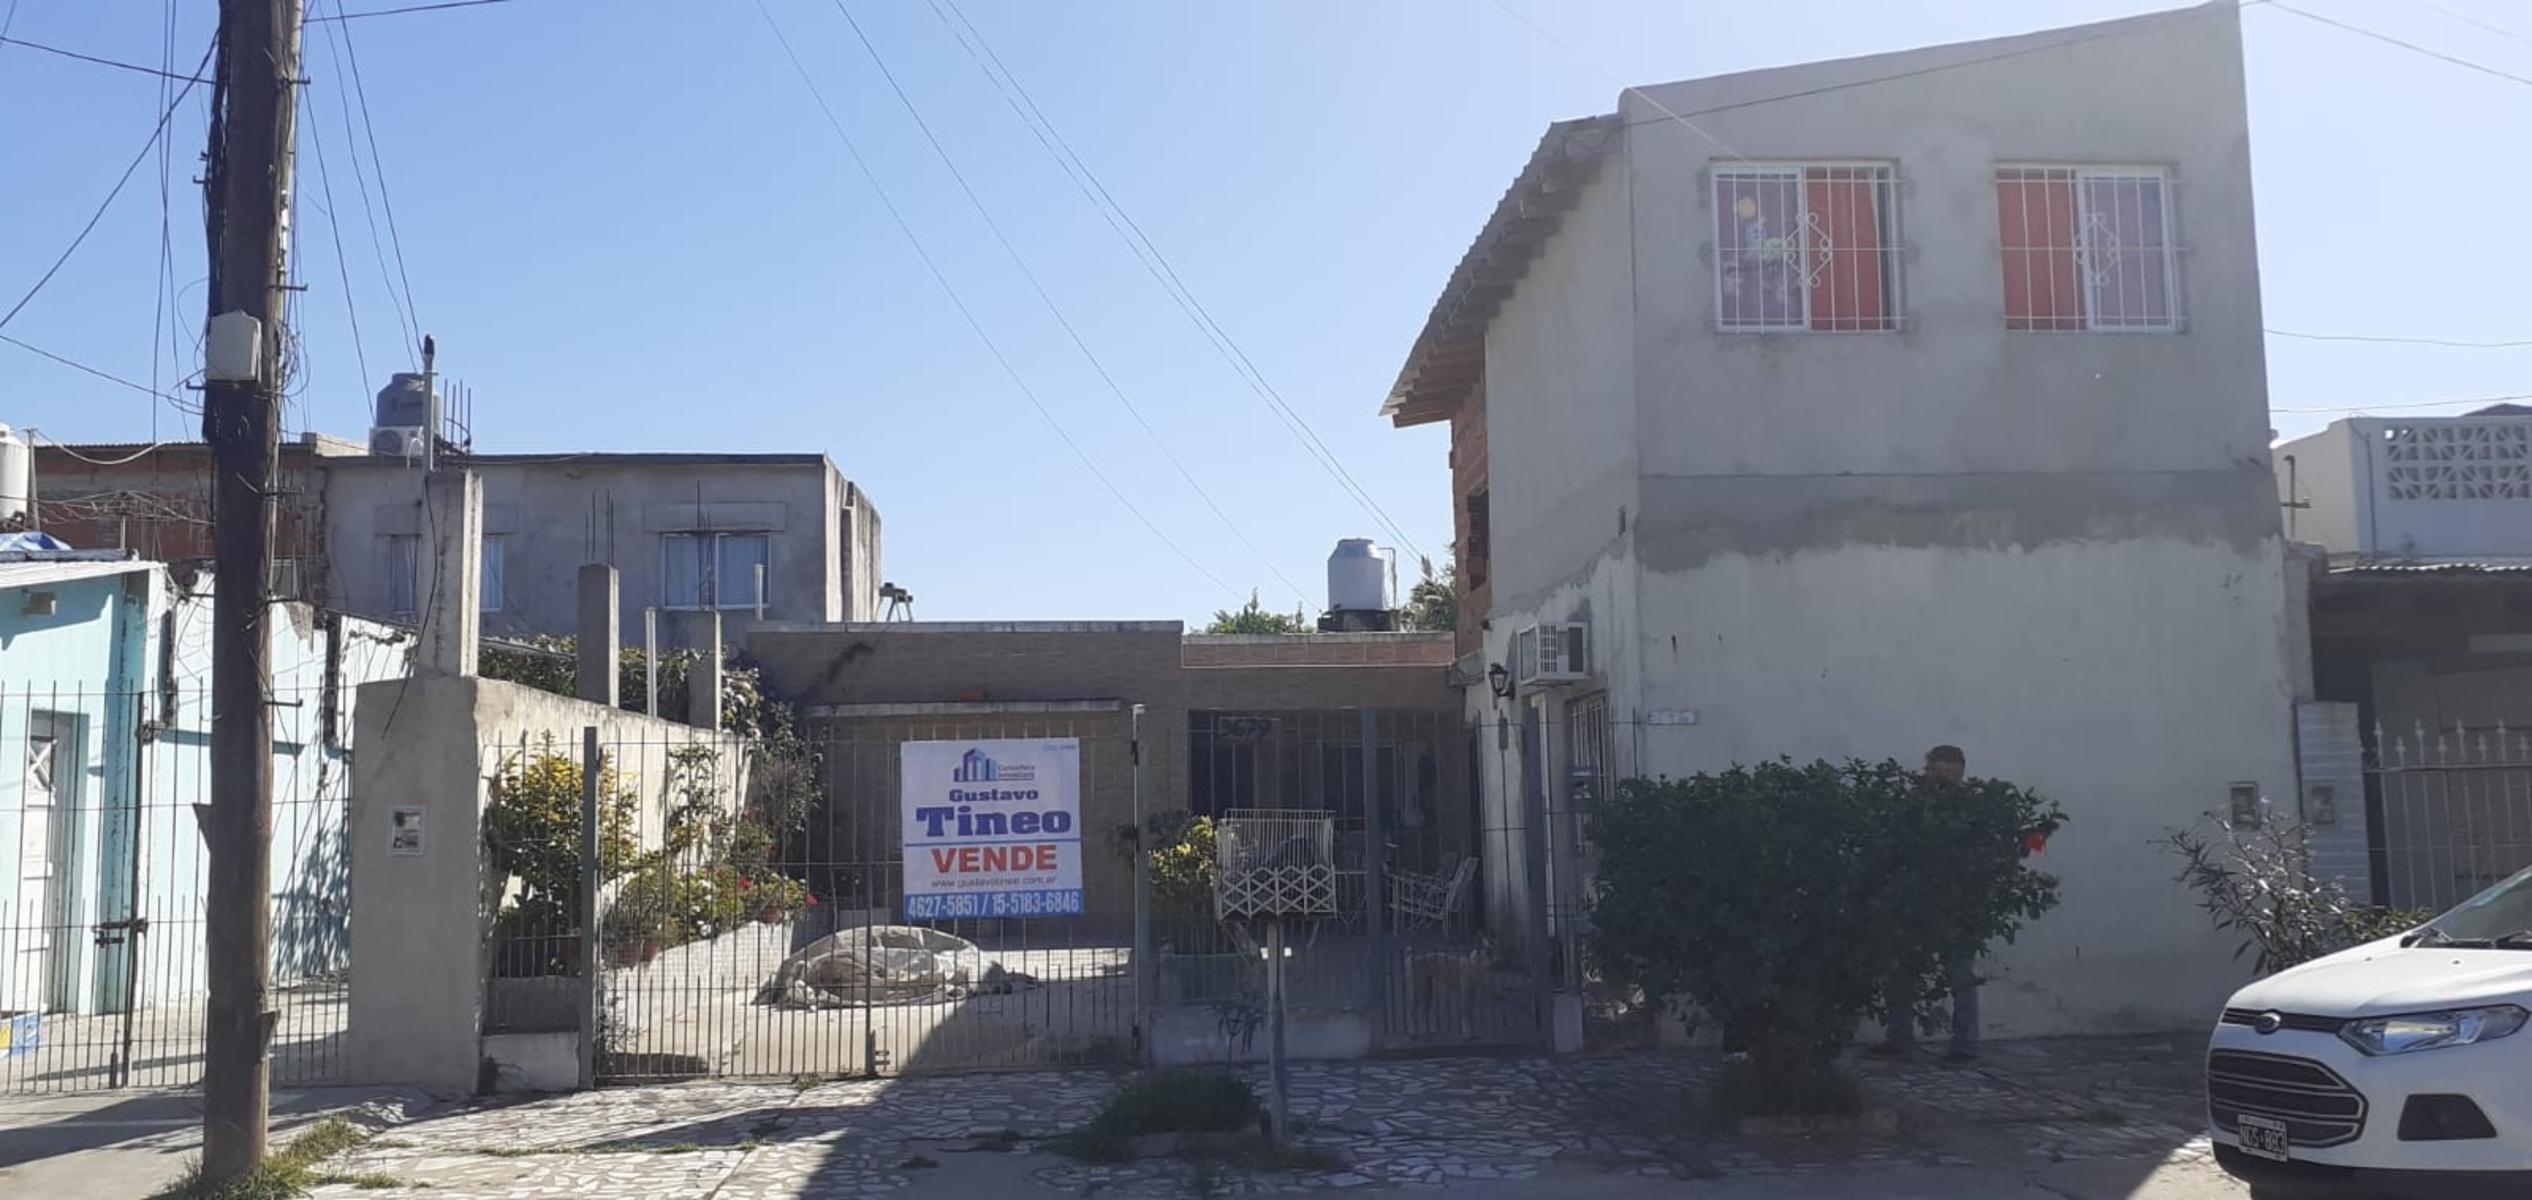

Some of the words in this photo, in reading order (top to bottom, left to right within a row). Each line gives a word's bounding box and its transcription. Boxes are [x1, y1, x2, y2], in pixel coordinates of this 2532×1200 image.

[949, 789, 1039, 802] Gustavo
[916, 805, 1071, 837] Tineo
[930, 845, 1057, 873] VENDE
